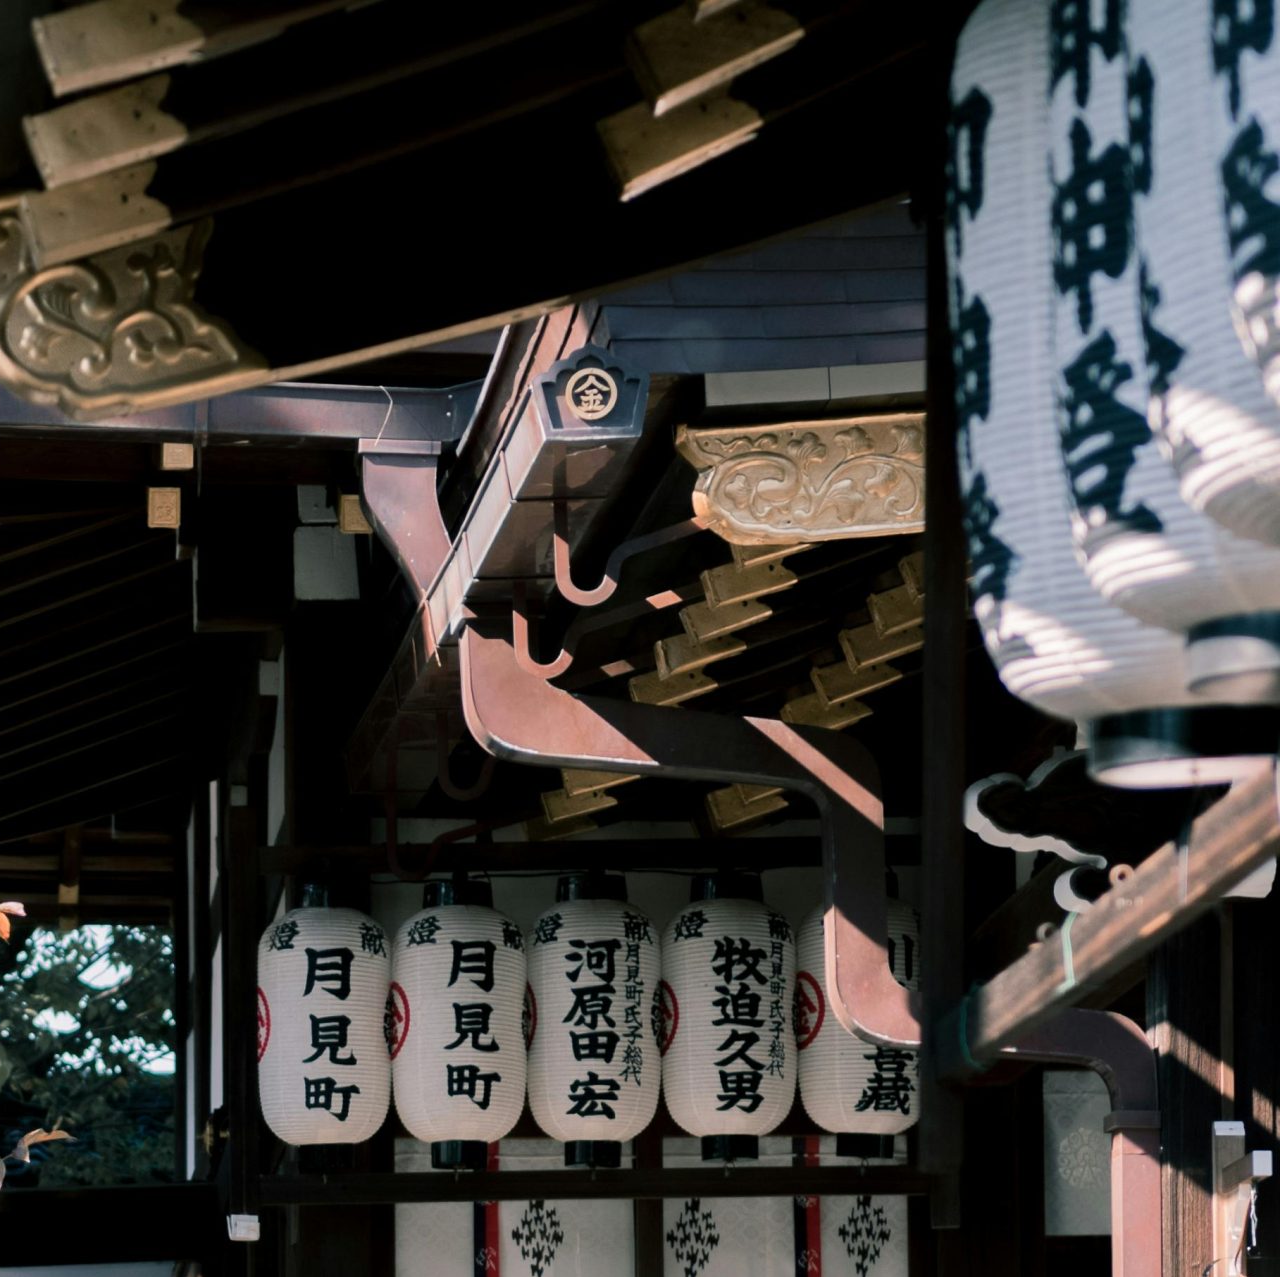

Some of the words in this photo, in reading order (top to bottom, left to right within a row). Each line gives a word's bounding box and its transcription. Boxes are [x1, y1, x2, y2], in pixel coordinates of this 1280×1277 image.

[302, 946, 361, 1122] 月見町
[444, 939, 502, 1111] 月見町
[562, 938, 622, 1120] 河原田宏
[710, 935, 770, 1114] 牧迫久男
